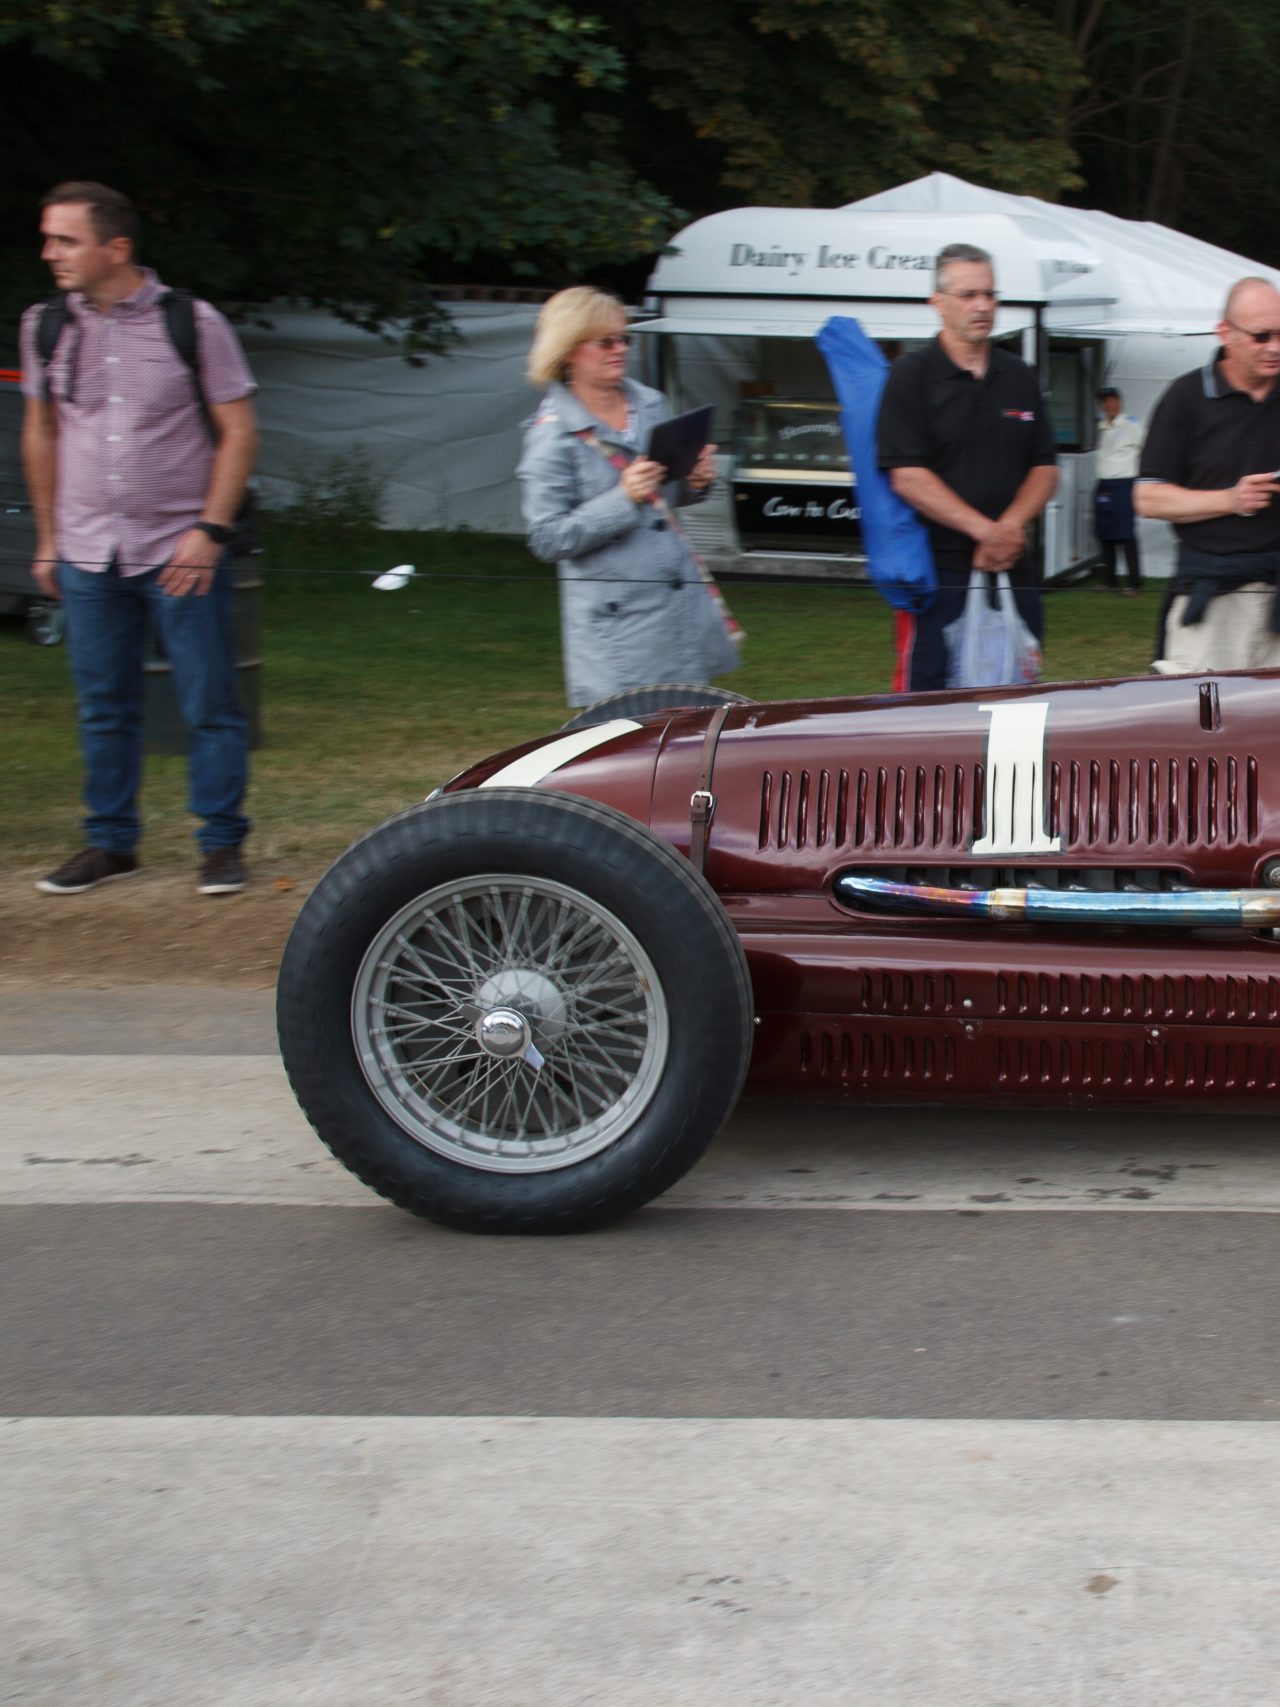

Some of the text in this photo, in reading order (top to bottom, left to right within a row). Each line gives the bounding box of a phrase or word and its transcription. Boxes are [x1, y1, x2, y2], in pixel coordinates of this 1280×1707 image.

[729, 243, 805, 276] Dairy
[816, 245, 861, 270] Ice
[971, 702, 1061, 856] 1
